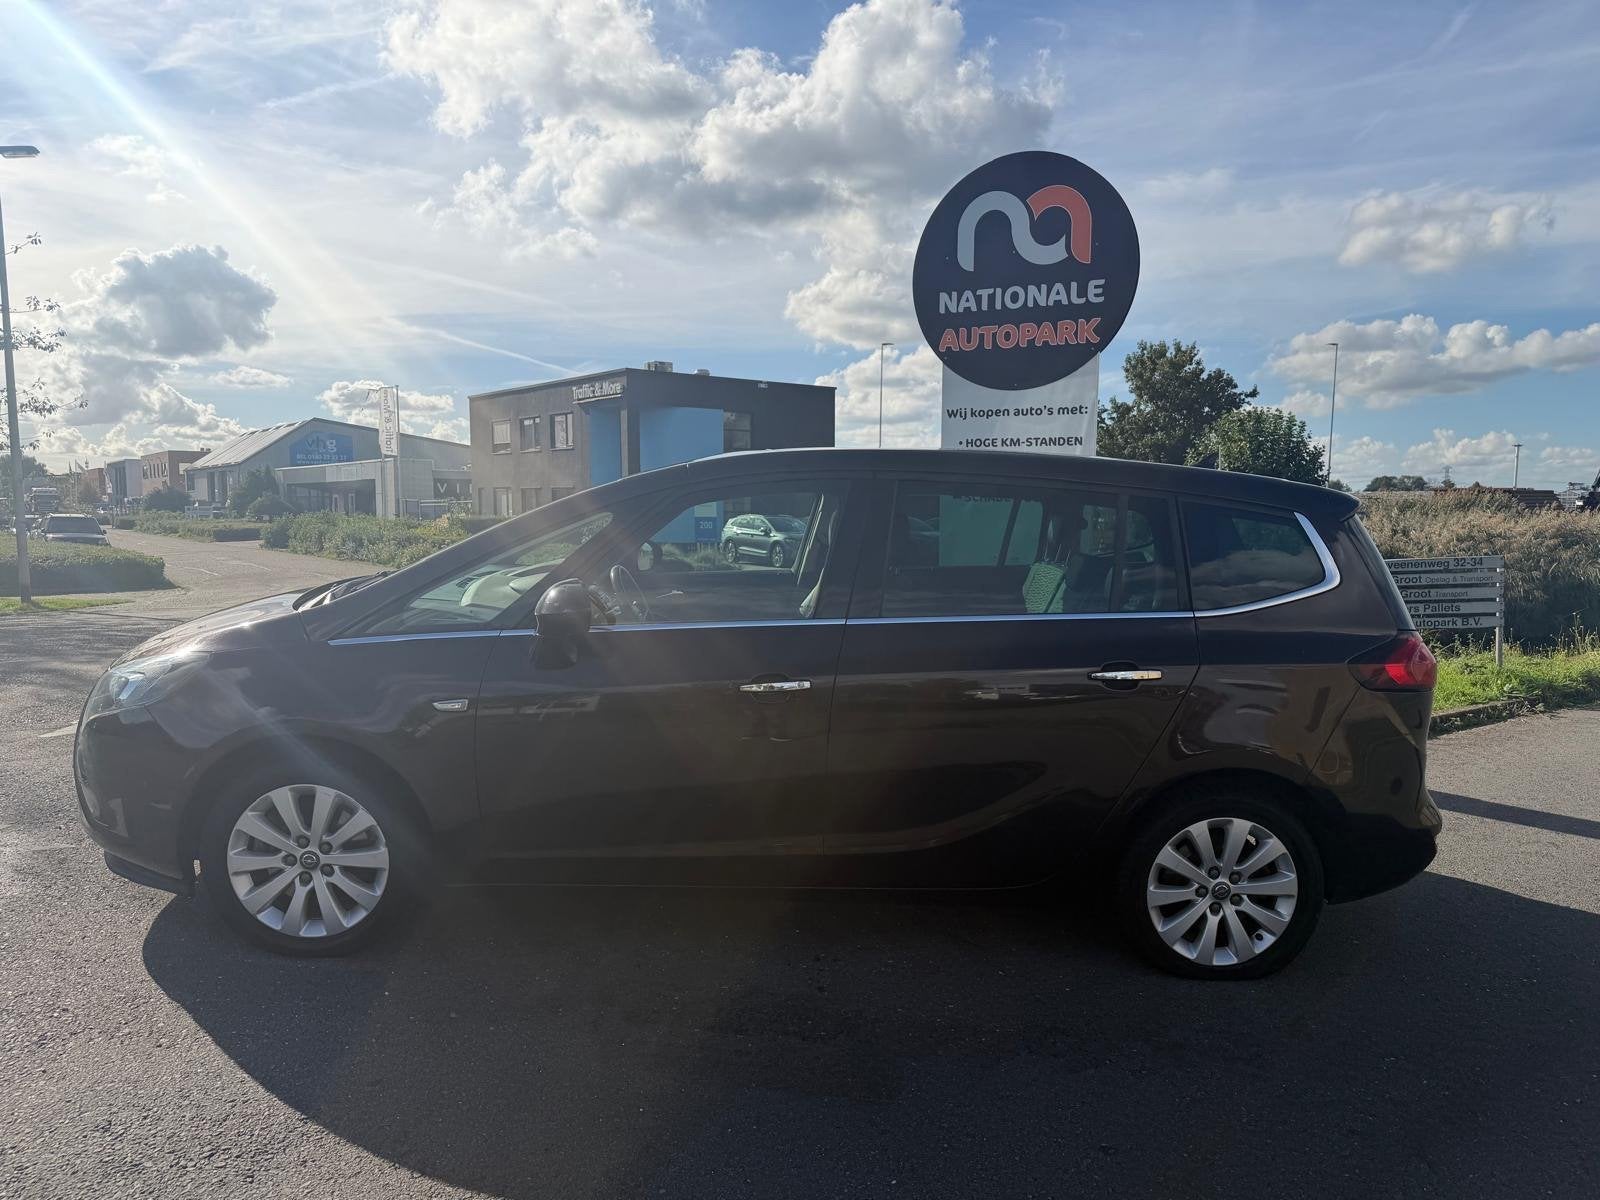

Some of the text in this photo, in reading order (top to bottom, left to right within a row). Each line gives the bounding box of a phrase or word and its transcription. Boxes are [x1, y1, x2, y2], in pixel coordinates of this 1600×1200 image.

[939, 279, 1105, 314] NATIONALE
[938, 317, 1102, 353] AUTOPARK
[572, 384, 593, 400] Traffic
[602, 381, 622, 396] More
[946, 404, 1088, 420] Wij kopen auto's met:
[965, 436, 1083, 448] HOGE KM-STANDEN
[1453, 557, 1484, 567] 32-34
[1401, 590, 1431, 599] Groot
[1424, 603, 1461, 612] Pallets
[1414, 617, 1482, 628] utopark B.V.
